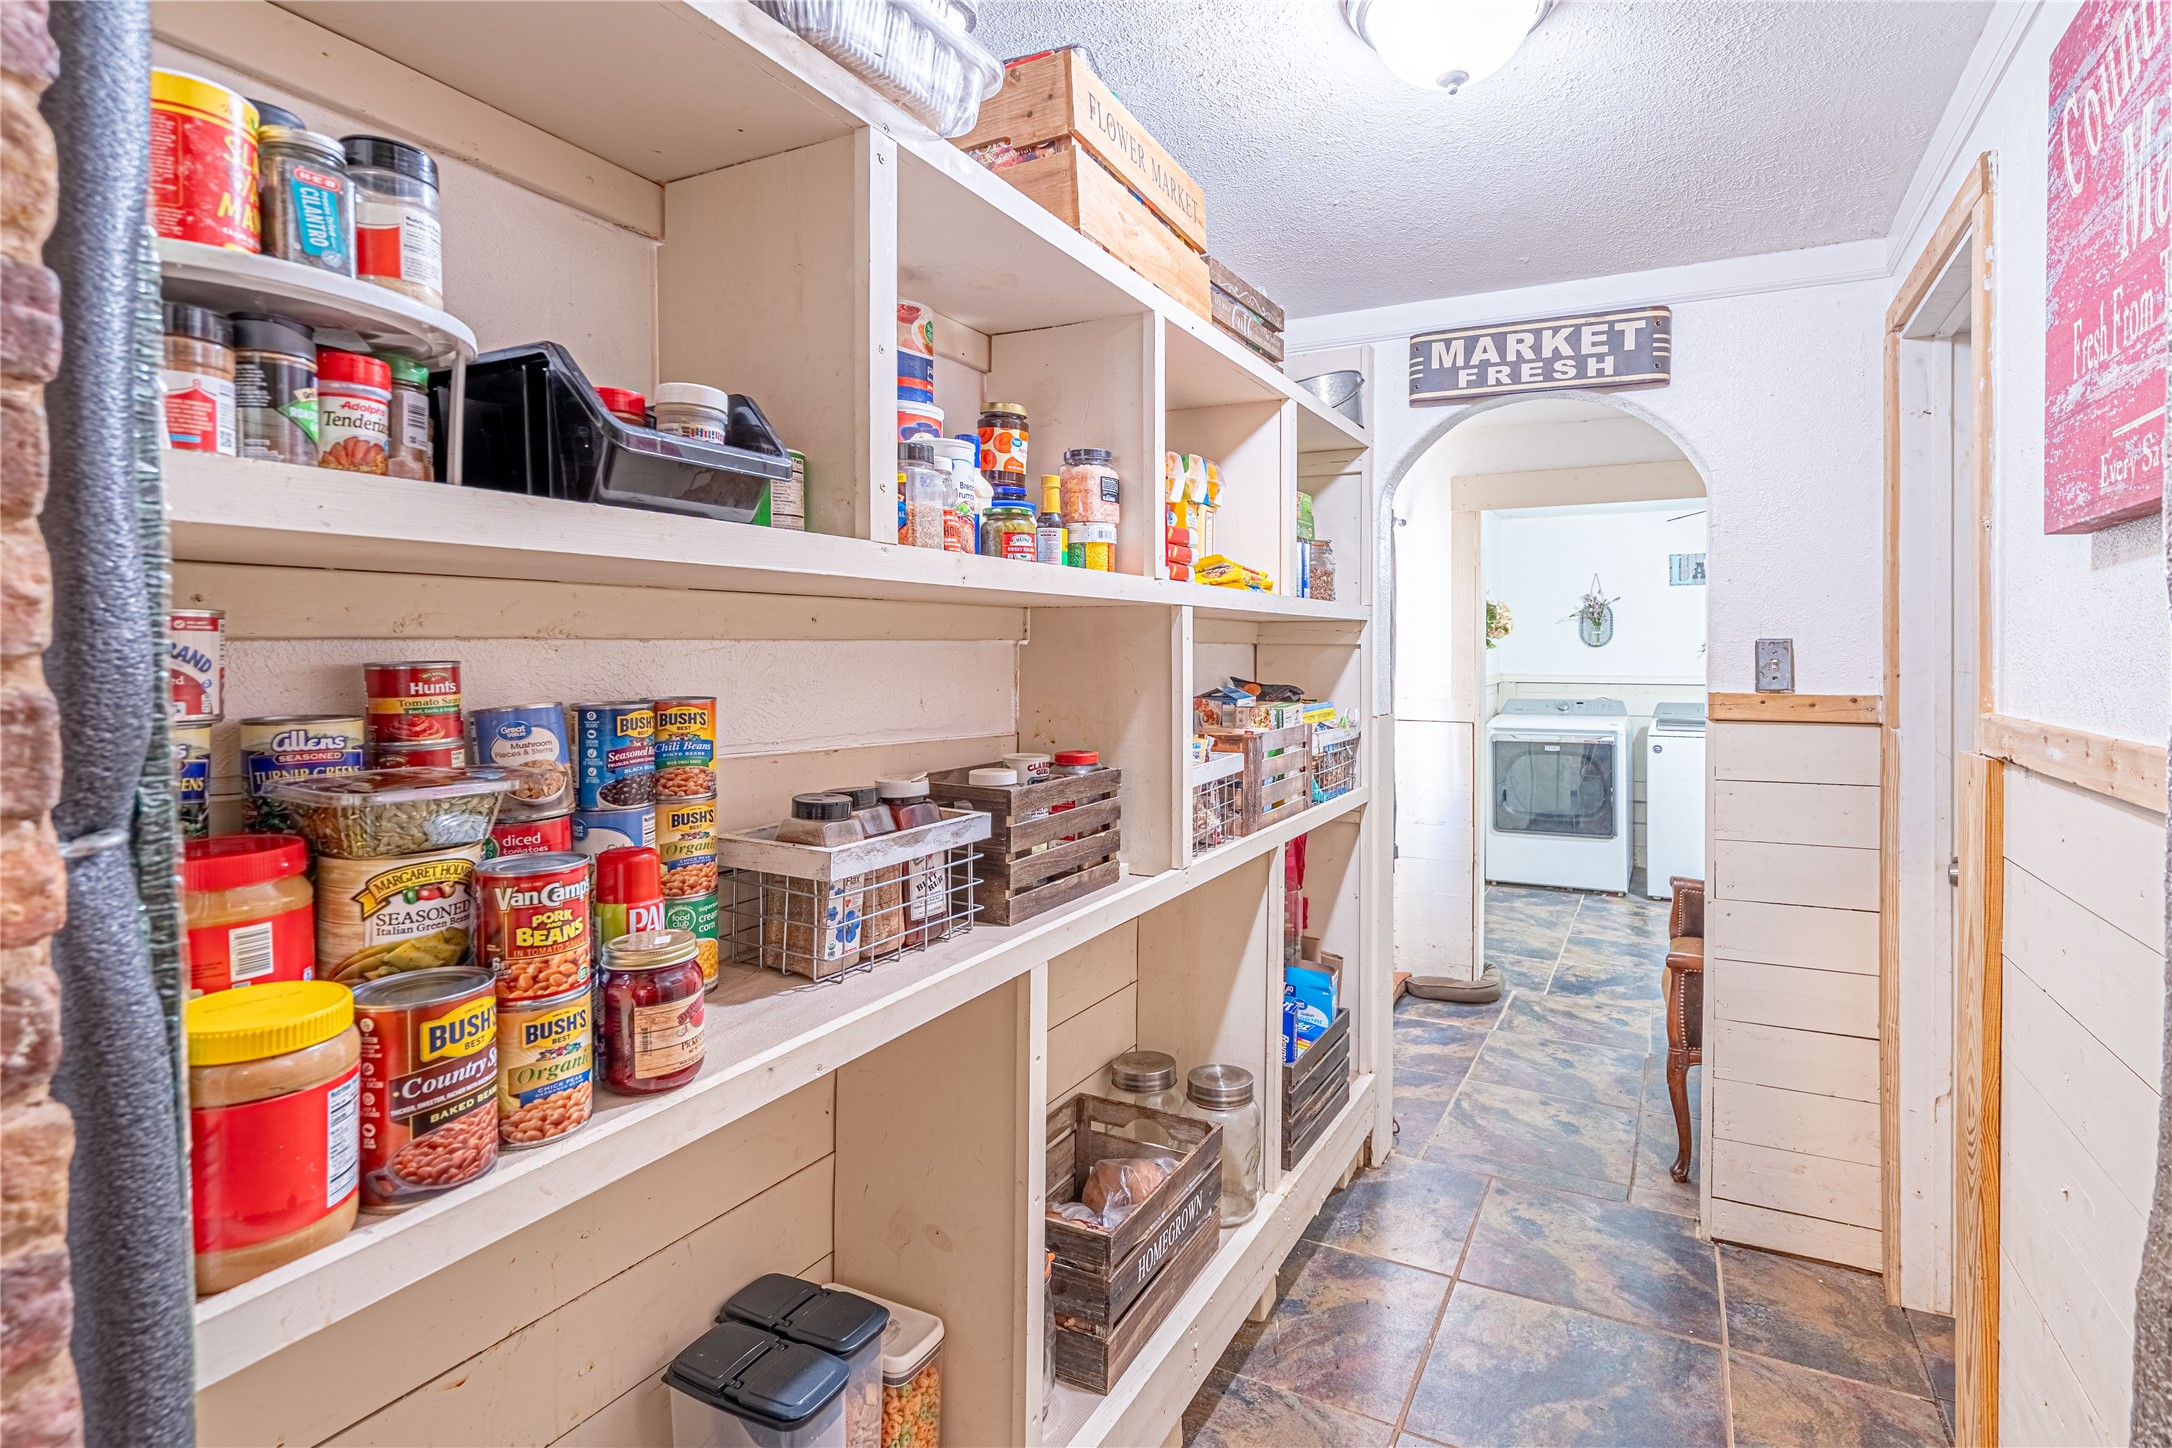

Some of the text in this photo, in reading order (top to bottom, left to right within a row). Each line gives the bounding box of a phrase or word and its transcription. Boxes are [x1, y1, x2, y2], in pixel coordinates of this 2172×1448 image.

[1088, 91, 1201, 225] FLOWER MARKET
[300, 186, 330, 248] CILANTRO
[2072, 284, 2155, 380] Fresh From
[1431, 319, 1647, 370] MARKET
[1458, 355, 1615, 389] FRESH
[2099, 447, 2138, 489] Every
[397, 698, 440, 708] Tomato
[659, 711, 707, 728] BUSH'S
[272, 729, 346, 752] Allens
[510, 740, 553, 751] Mushroom
[654, 741, 681, 753] Chili
[683, 741, 712, 751] Beans
[278, 752, 342, 763] SEASONED
[494, 751, 522, 759] Pieces
[531, 747, 553, 755] Stems
[608, 746, 649, 762] Seasoned
[254, 767, 310, 785] TURNIP
[624, 766, 644, 774] BLACK
[671, 808, 714, 829] BUSH'S
[502, 832, 541, 847] diced
[503, 845, 549, 856] tomatoes
[373, 865, 439, 894] MARGARET
[376, 898, 471, 927] SEASONED
[531, 909, 574, 928] PORK
[671, 913, 691, 921] food
[376, 926, 414, 937] Italian
[416, 919, 448, 932] Green
[515, 916, 584, 947] BEANS
[672, 920, 690, 928] club
[698, 921, 716, 933] corn
[526, 943, 564, 956] TOMATO
[525, 1008, 587, 1046] BUSH'S
[464, 1034, 486, 1051] BEST
[552, 1033, 571, 1045] BEST
[401, 1056, 488, 1099] Country
[537, 1074, 583, 1094] CHICK PEAS
[534, 1083, 568, 1098] GARBANZO
[430, 1098, 475, 1124] BAKED
[1136, 1190, 1204, 1284] HOMEGROWN
